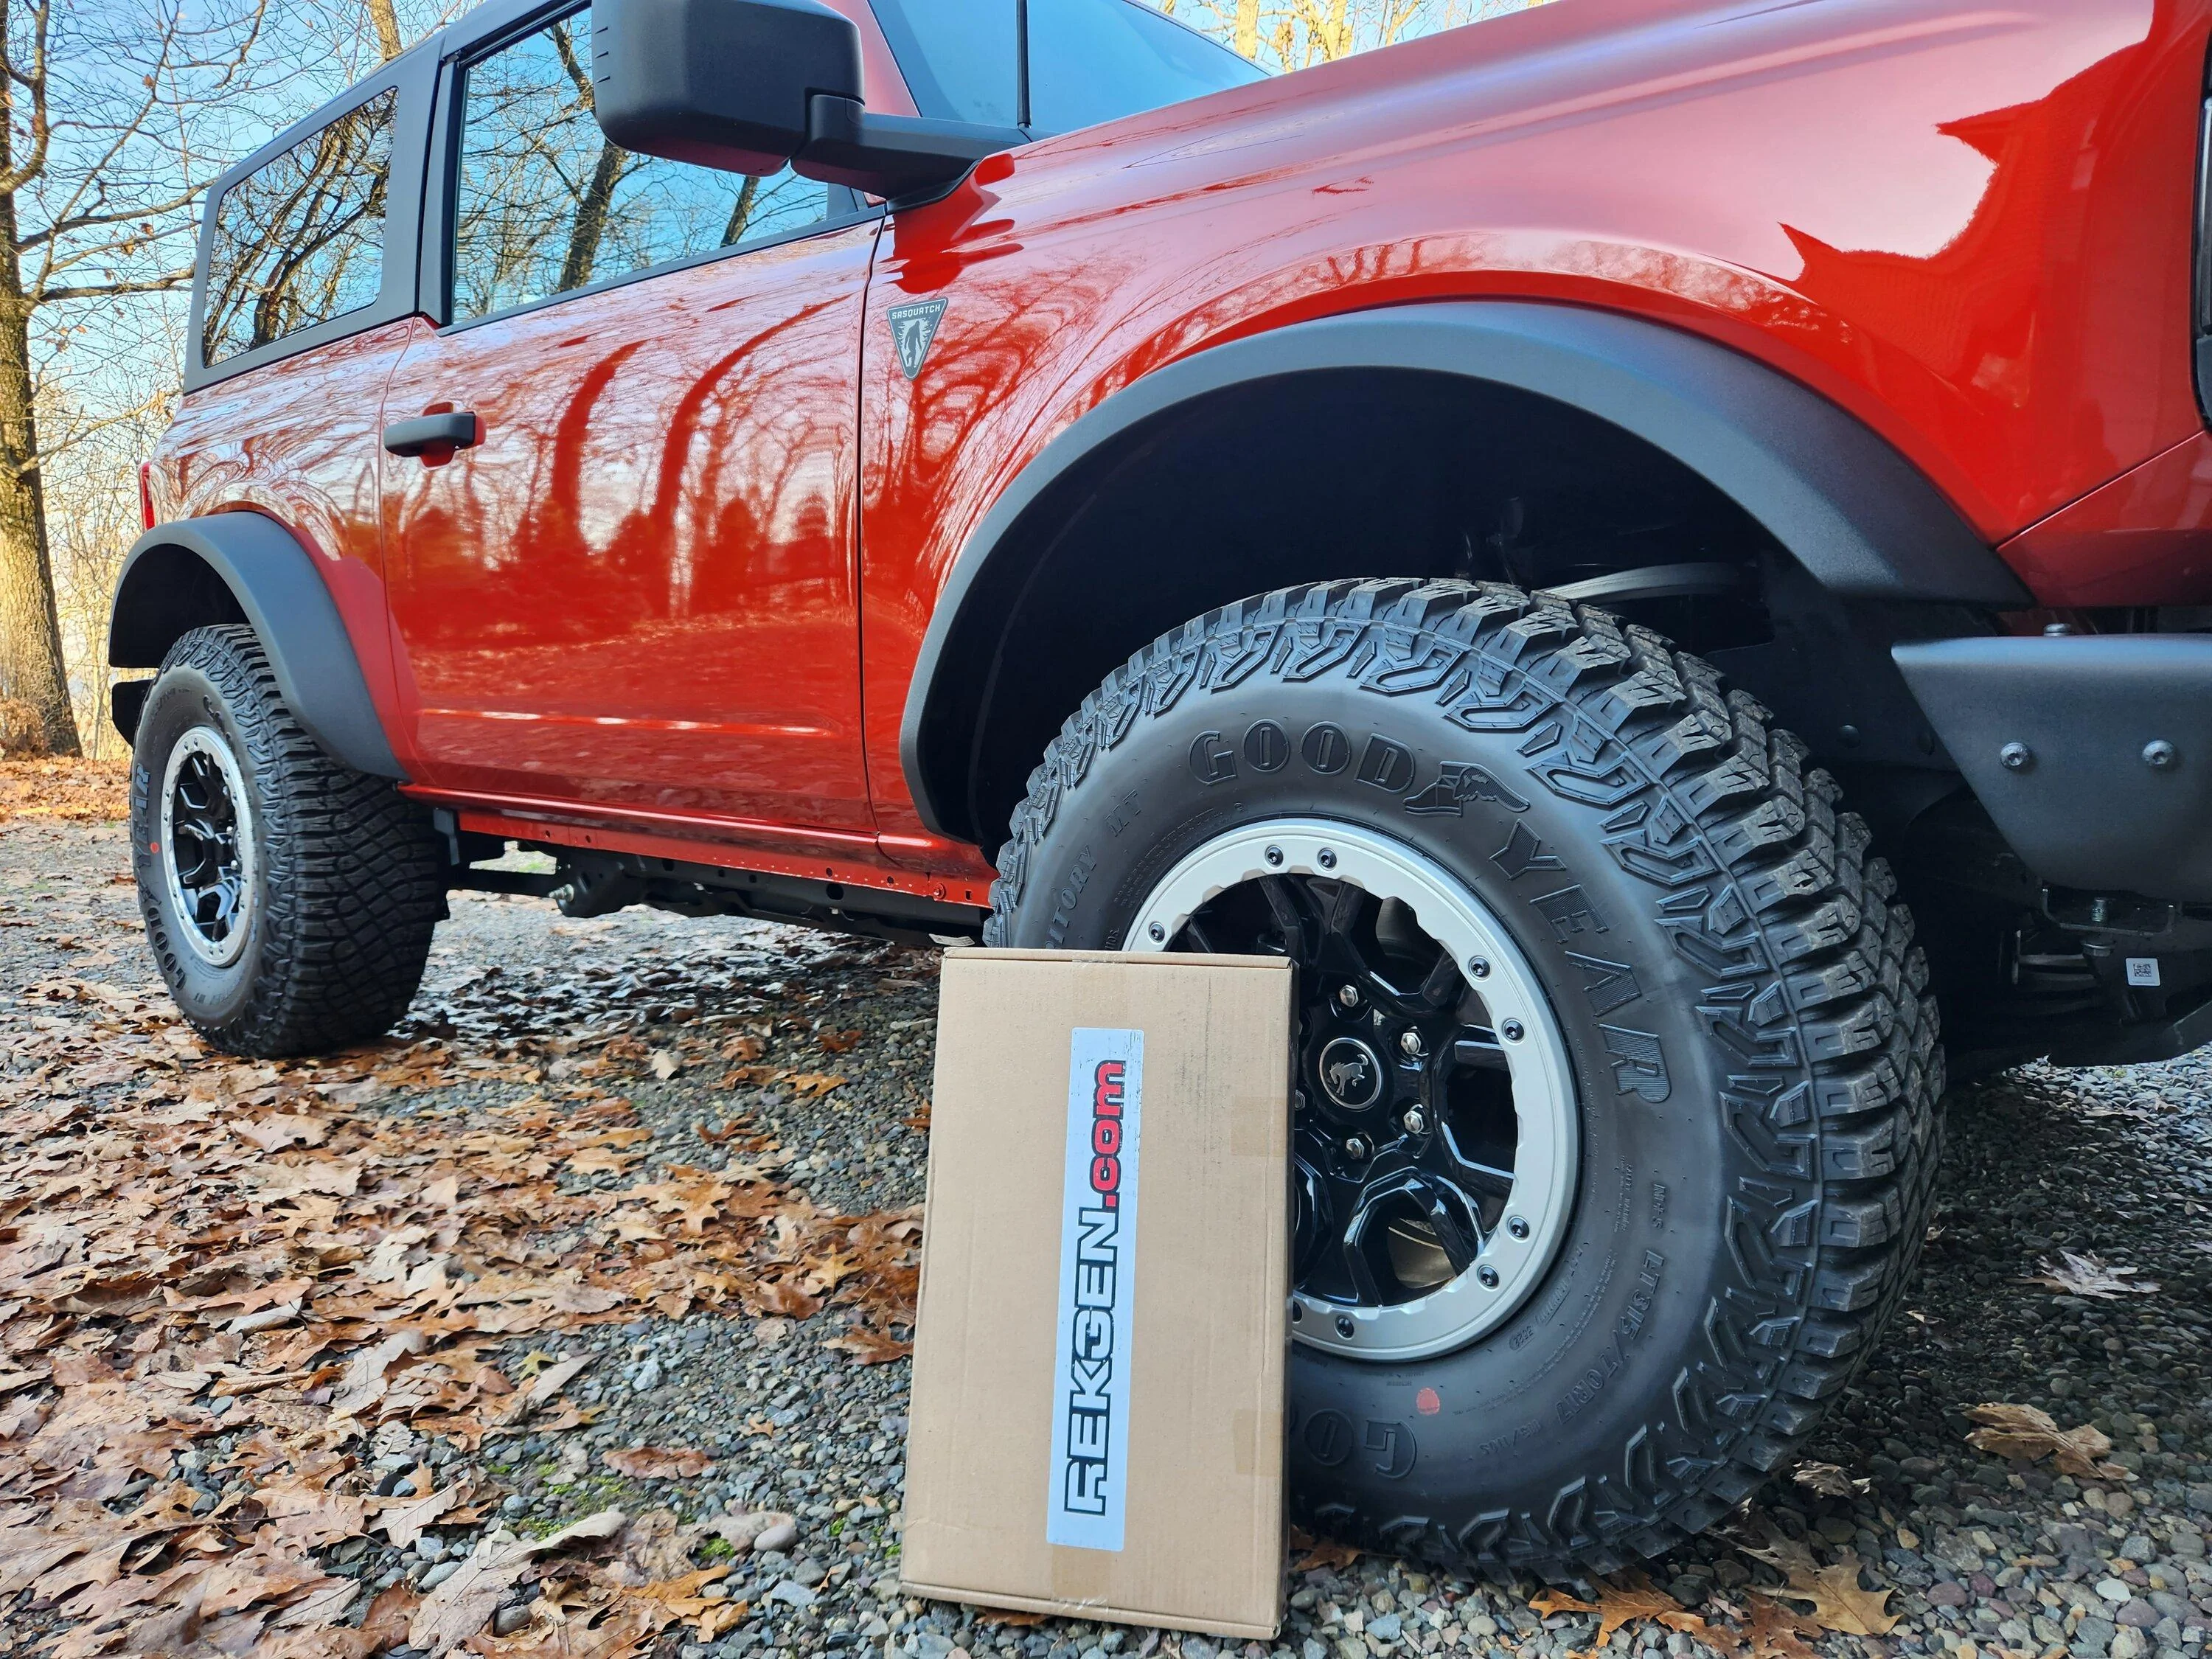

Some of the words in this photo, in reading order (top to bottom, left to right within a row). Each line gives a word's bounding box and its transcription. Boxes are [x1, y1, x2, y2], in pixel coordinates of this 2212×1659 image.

[891, 304, 941, 320] SASQUATCH
[1187, 718, 1416, 794] GOOD
[1488, 818, 1671, 1104] YEAR
[1652, 1183, 1667, 1230] M+S
[1065, 1059, 1127, 1517] REKGEN.com
[1290, 1408, 1417, 1481] GO
